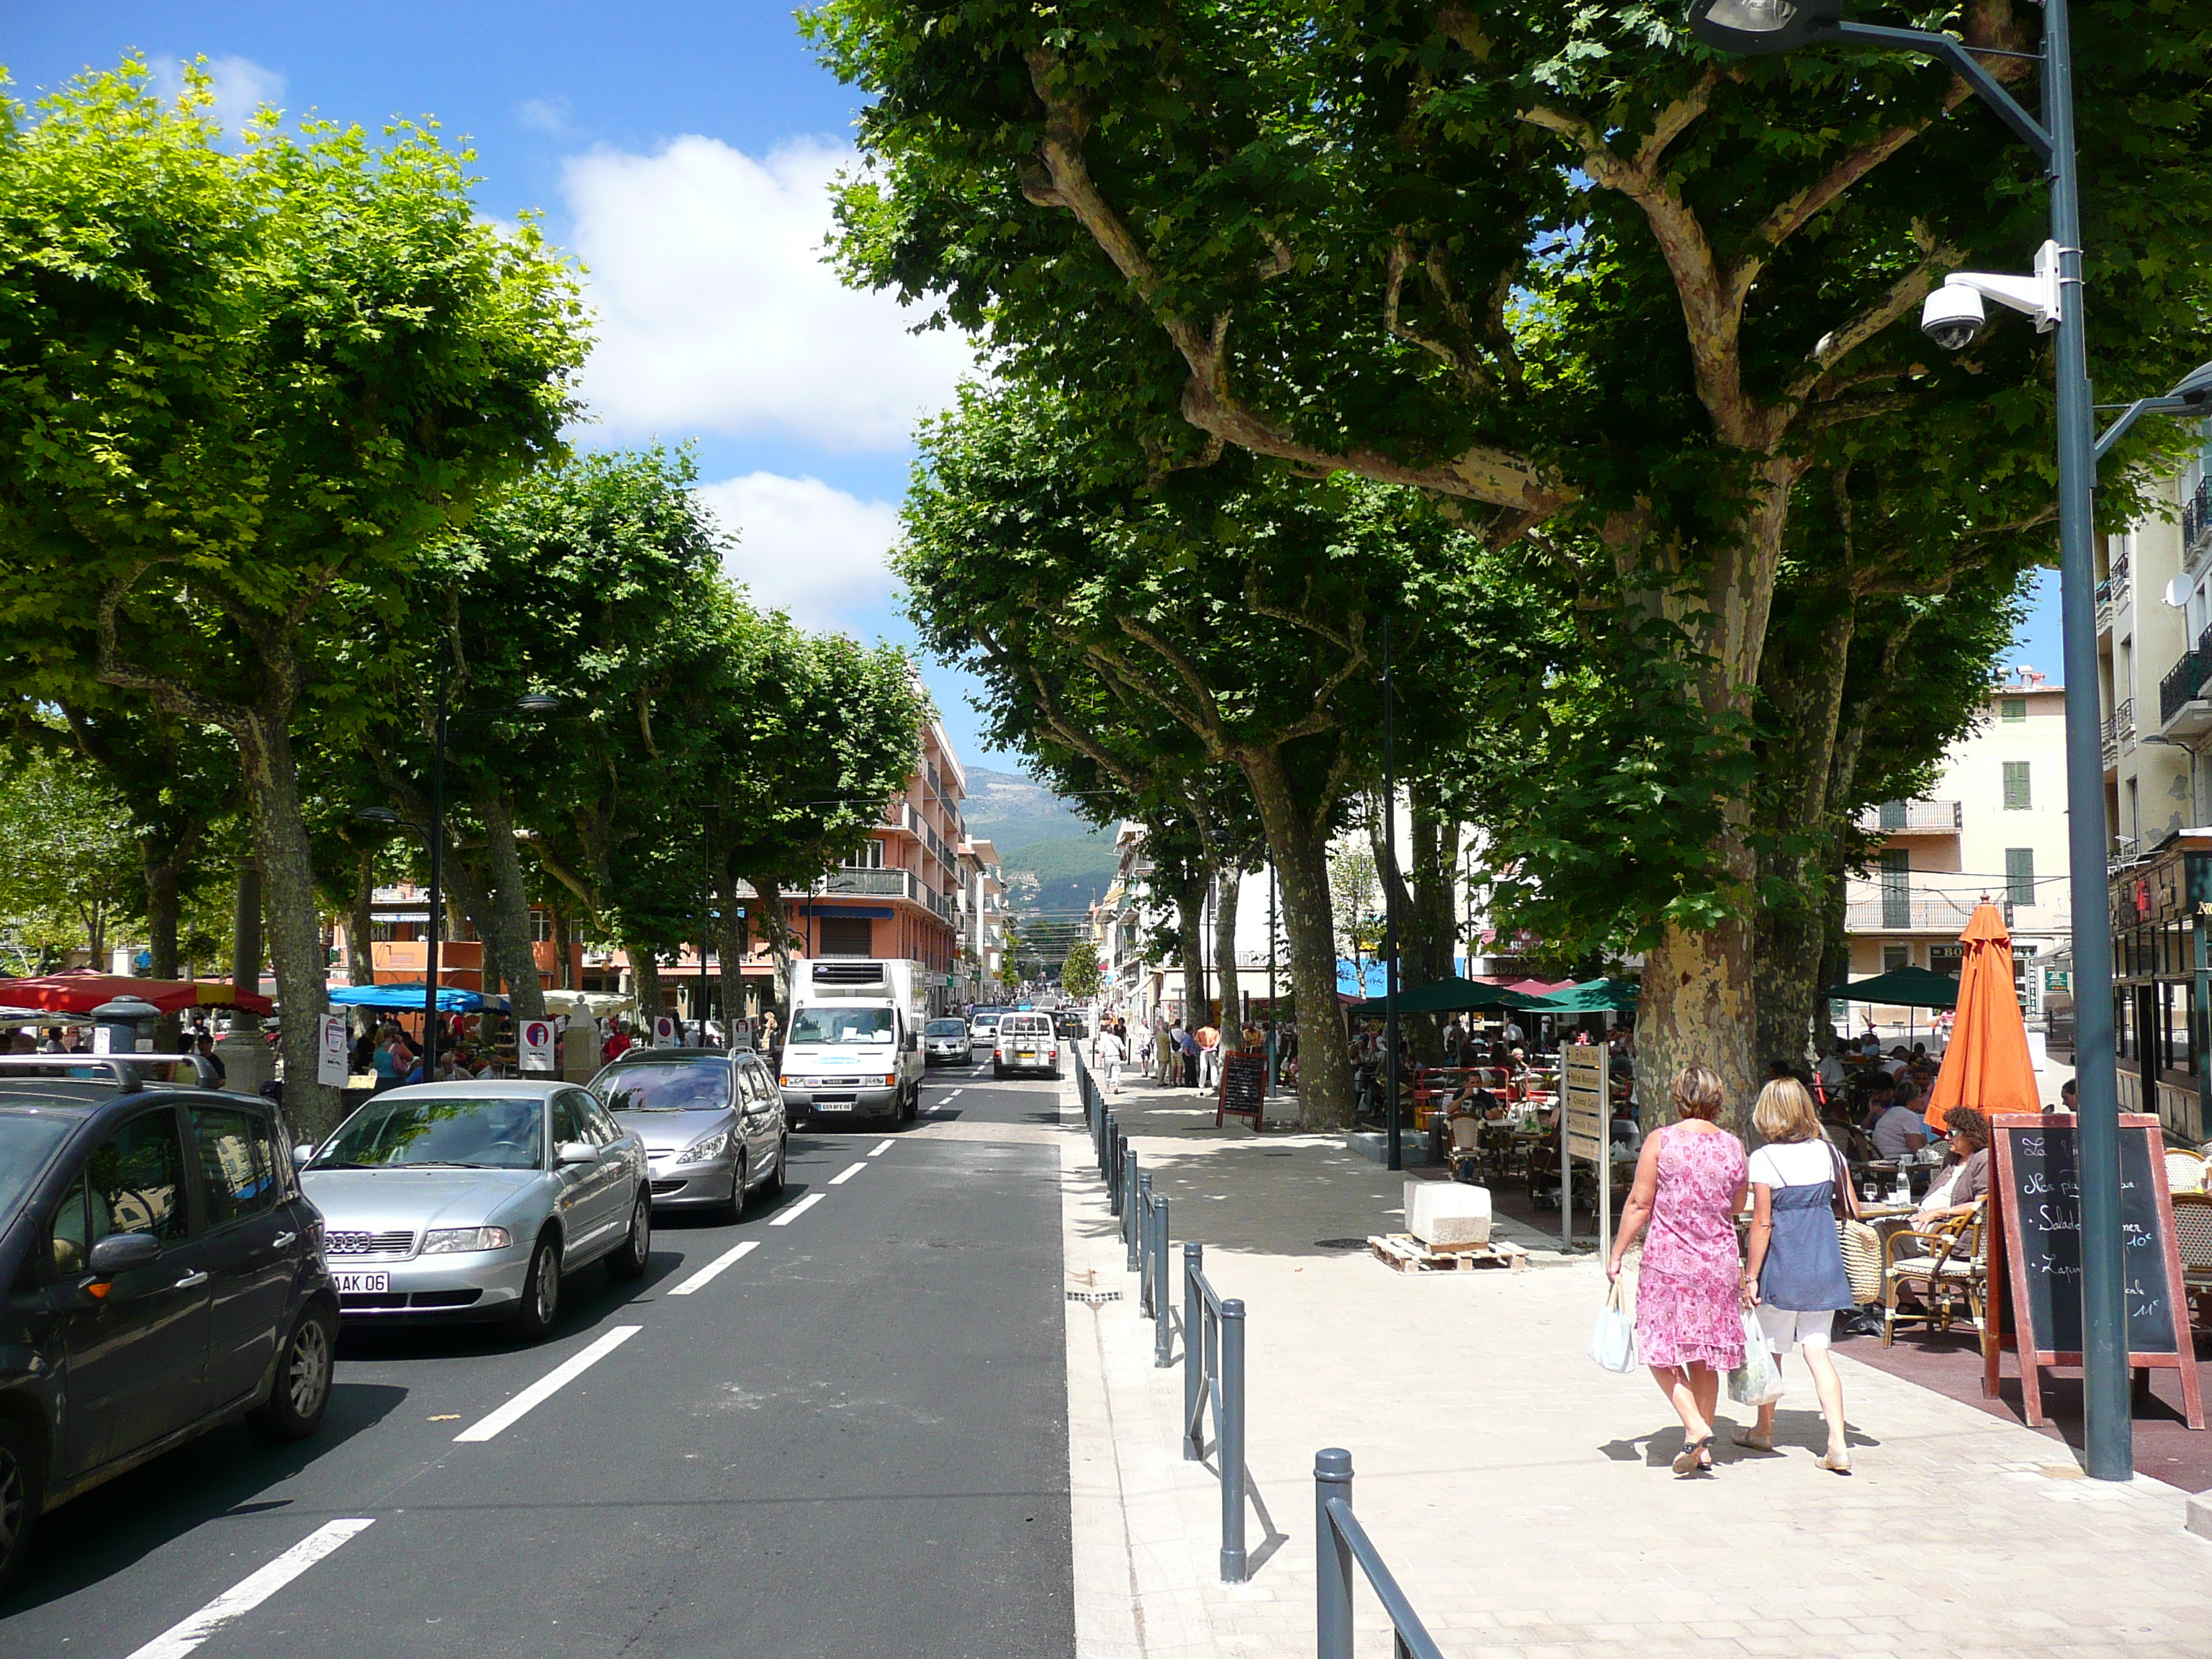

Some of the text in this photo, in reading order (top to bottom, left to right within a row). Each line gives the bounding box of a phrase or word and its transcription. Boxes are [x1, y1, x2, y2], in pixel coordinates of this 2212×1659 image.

[2022, 1137, 2049, 1156] La
[2024, 1173, 2055, 1195] Nos
[365, 1275, 385, 1291] 06
